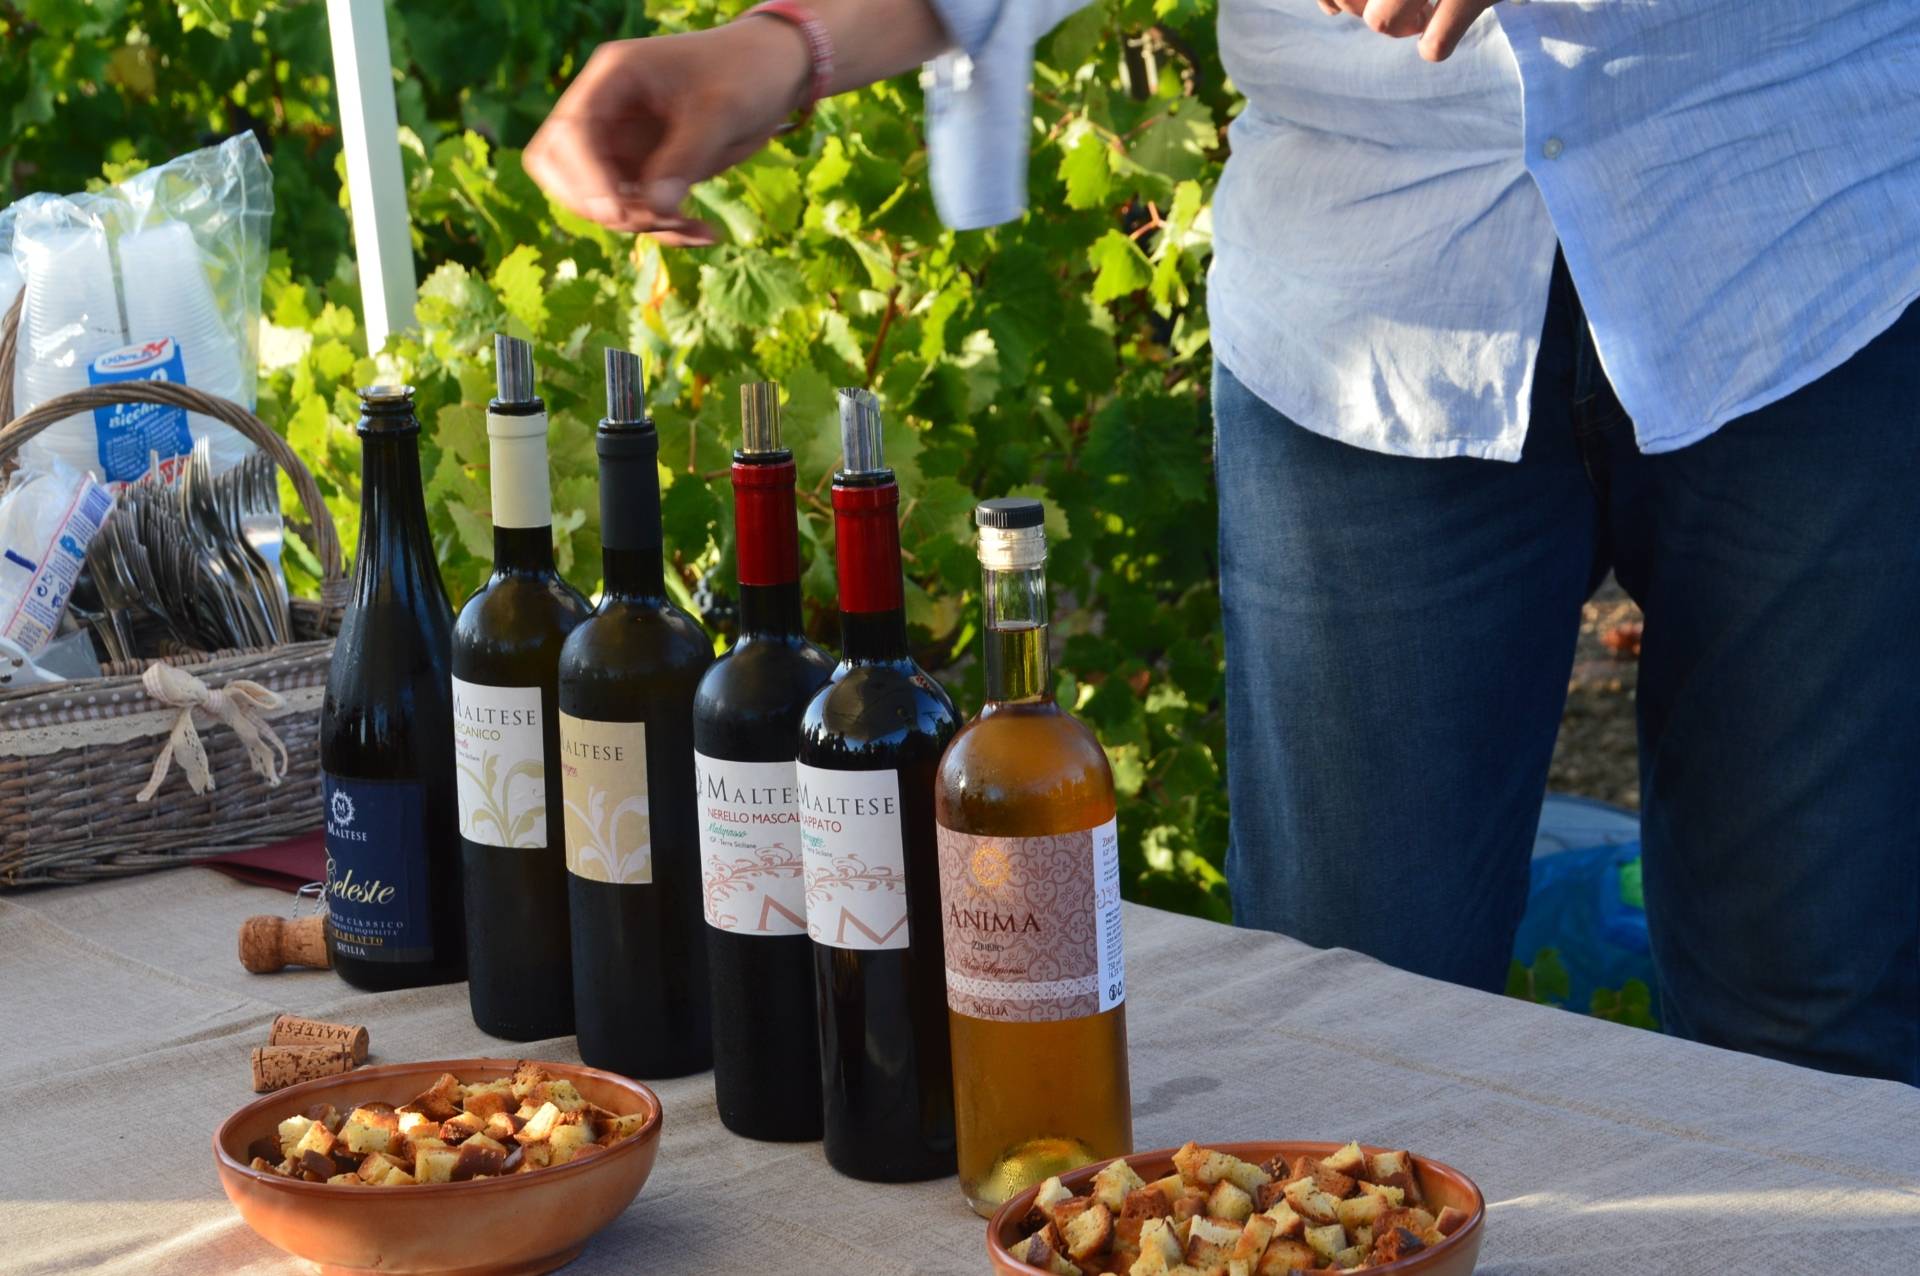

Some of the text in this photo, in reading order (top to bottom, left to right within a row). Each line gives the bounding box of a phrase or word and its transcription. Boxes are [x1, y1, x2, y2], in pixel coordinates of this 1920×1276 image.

[454, 693, 536, 726] MALTESE
[708, 773, 799, 804] MALTE
[799, 782, 895, 816] MALTESE
[708, 807, 750, 823] NERELLO
[327, 820, 368, 842] MALTESE
[950, 901, 1041, 933] ANIMA
[336, 941, 366, 956] SICILIA
